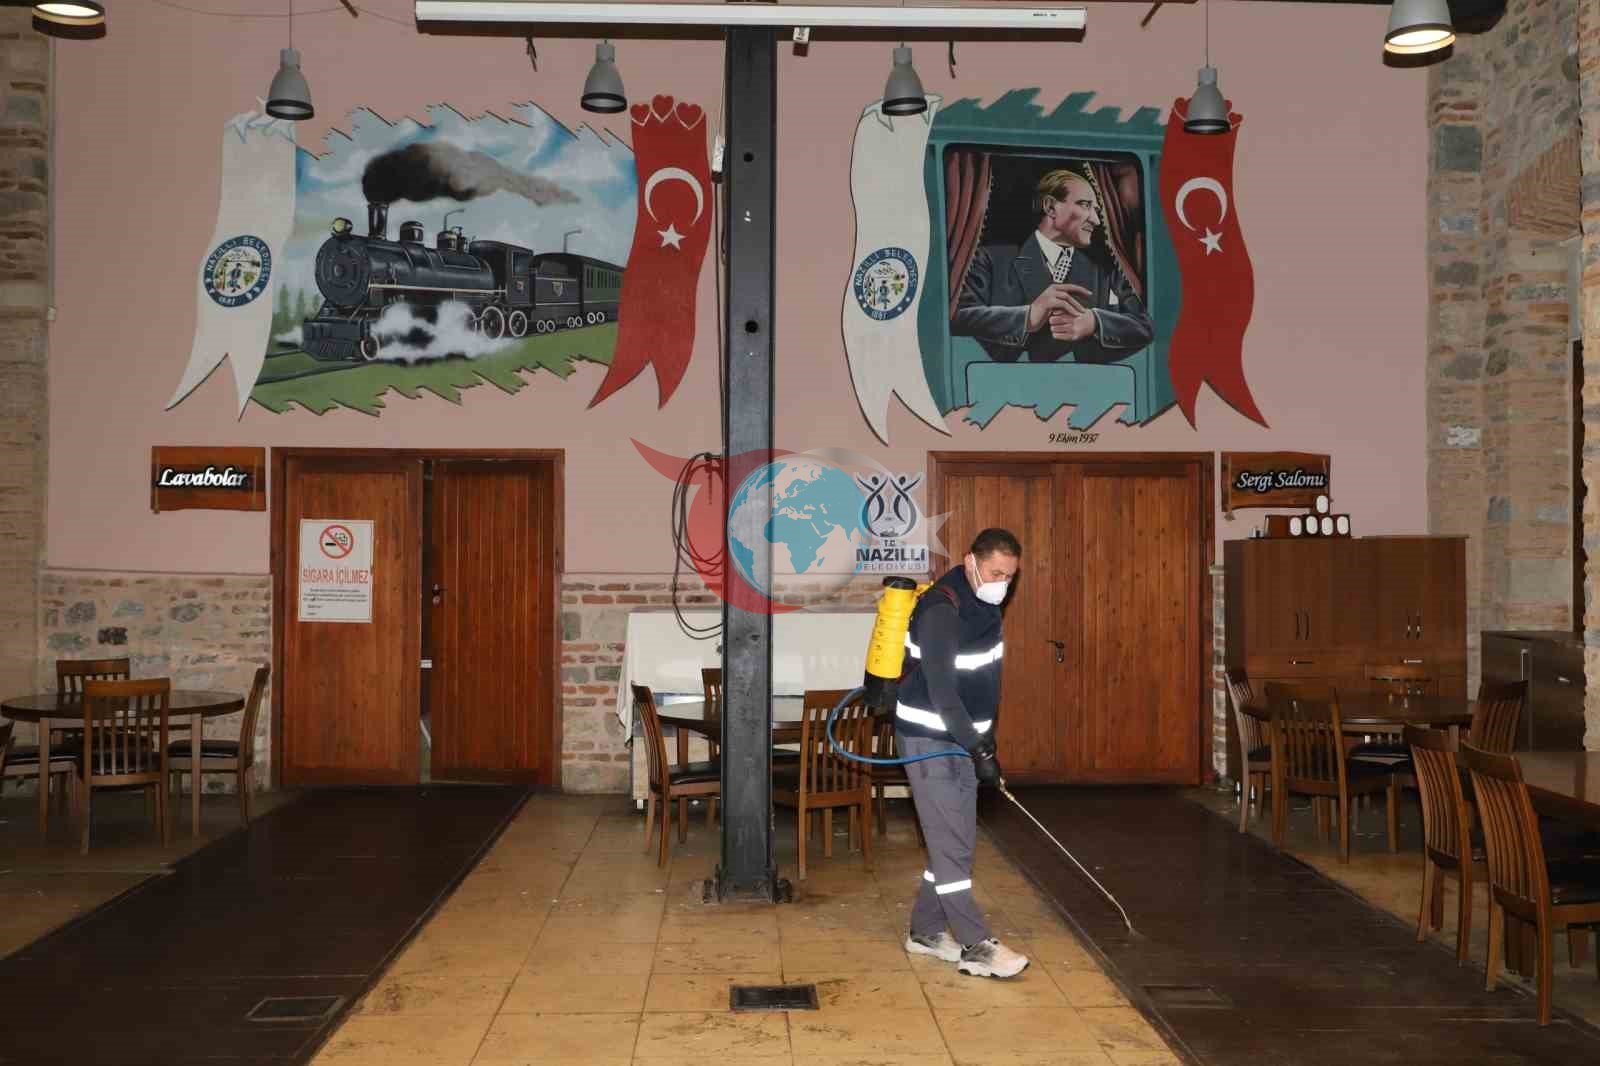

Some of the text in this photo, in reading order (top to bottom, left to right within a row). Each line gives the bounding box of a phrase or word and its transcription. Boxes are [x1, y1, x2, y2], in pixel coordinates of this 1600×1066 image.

[1048, 432, 1056, 444] 9
[1056, 432, 1078, 444] Ekim
[158, 466, 247, 487] Lavabolar
[1236, 469, 1324, 492] Sergi Salonu
